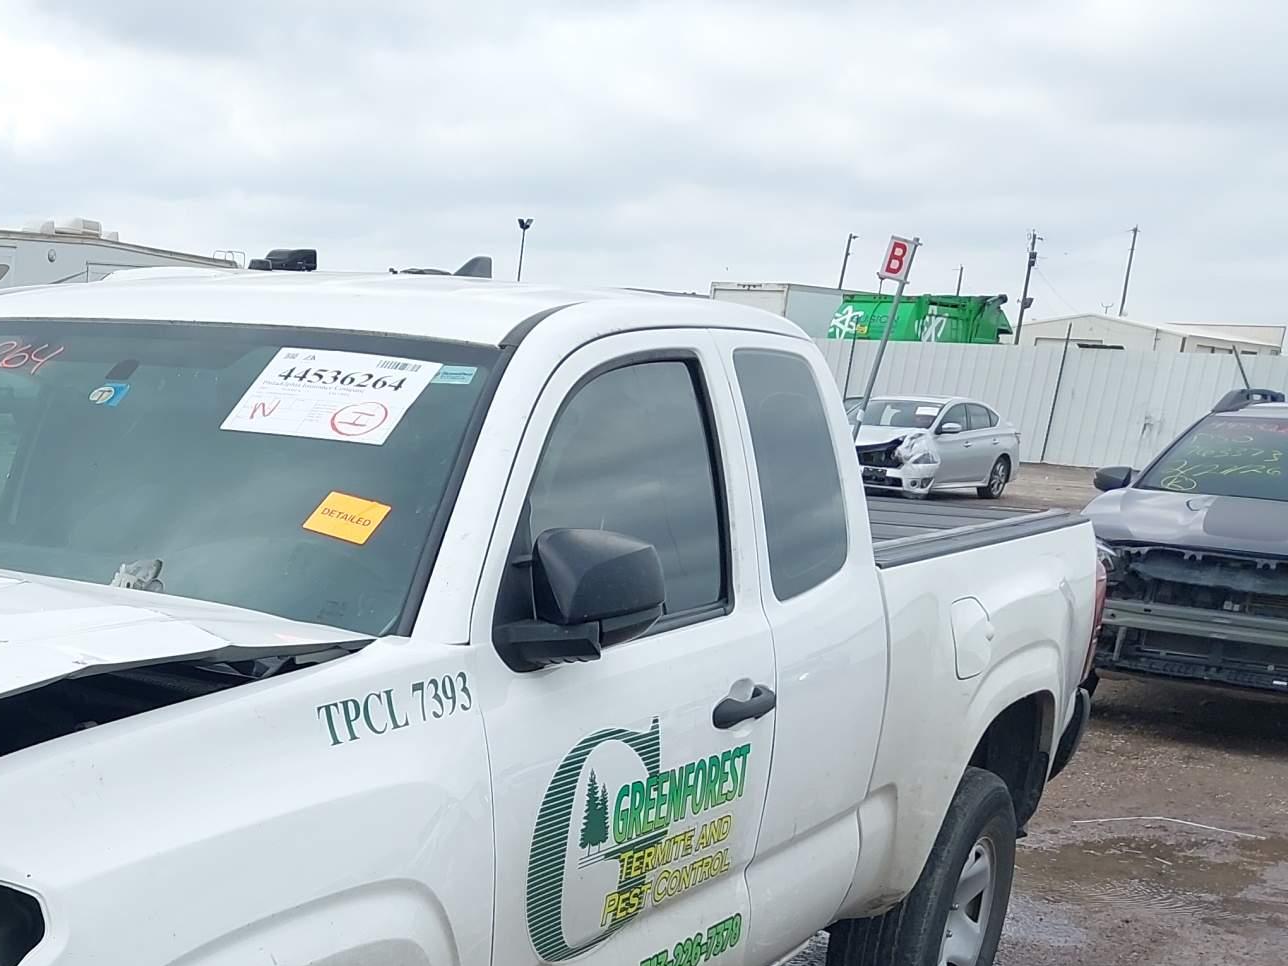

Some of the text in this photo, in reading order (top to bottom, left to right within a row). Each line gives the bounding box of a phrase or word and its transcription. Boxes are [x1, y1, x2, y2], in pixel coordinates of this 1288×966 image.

[884, 240, 908, 275] B
[278, 366, 407, 392] 44536264
[321, 507, 372, 527] DETAILED
[317, 671, 472, 746] TPCL 7393
[612, 744, 751, 844] GREENFOREST
[619, 815, 732, 881] TERMITE AND
[601, 848, 730, 928] PEST CONTROL
